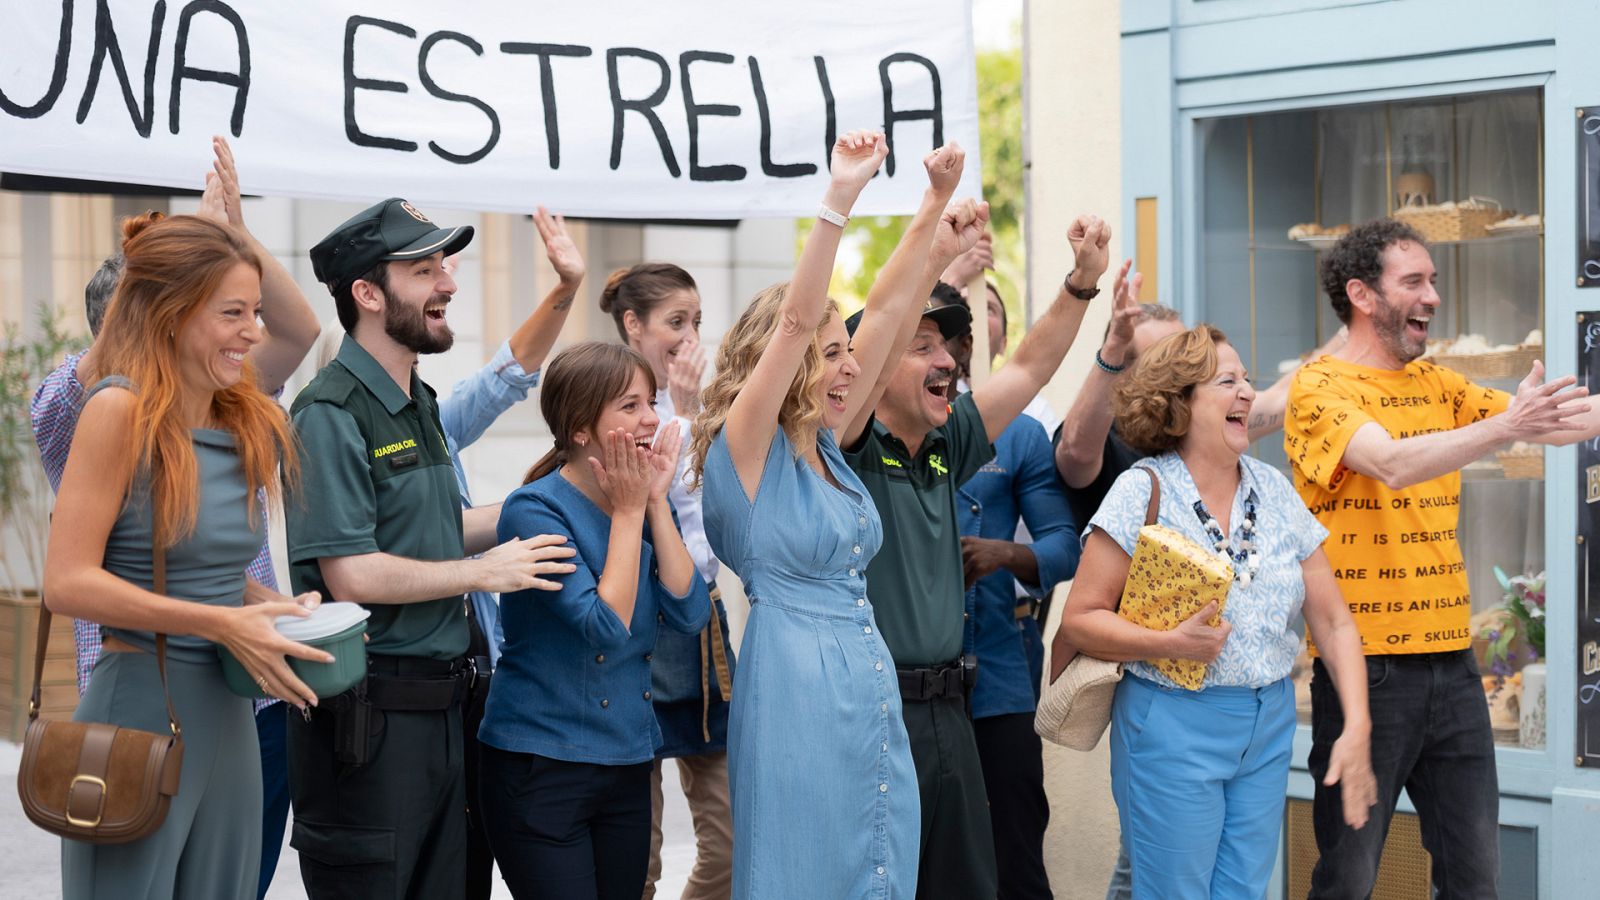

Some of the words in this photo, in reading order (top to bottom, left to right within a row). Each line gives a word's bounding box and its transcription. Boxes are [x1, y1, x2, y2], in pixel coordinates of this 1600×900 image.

[344, 14, 944, 182] ESTRELLA
[1343, 498, 1382, 510] FULL
[1391, 497, 1412, 510] OF
[1341, 533, 1357, 545] IT
[1373, 533, 1389, 545] IS
[1334, 568, 1367, 580] ARE
[1378, 568, 1407, 580] HIS
[1349, 602, 1382, 614] ERE
[1386, 602, 1404, 613] IS
[1408, 599, 1431, 612] AN
[1435, 594, 1471, 610] ISLAN
[1386, 633, 1412, 645] OF
[1424, 627, 1470, 643] SKULLS
